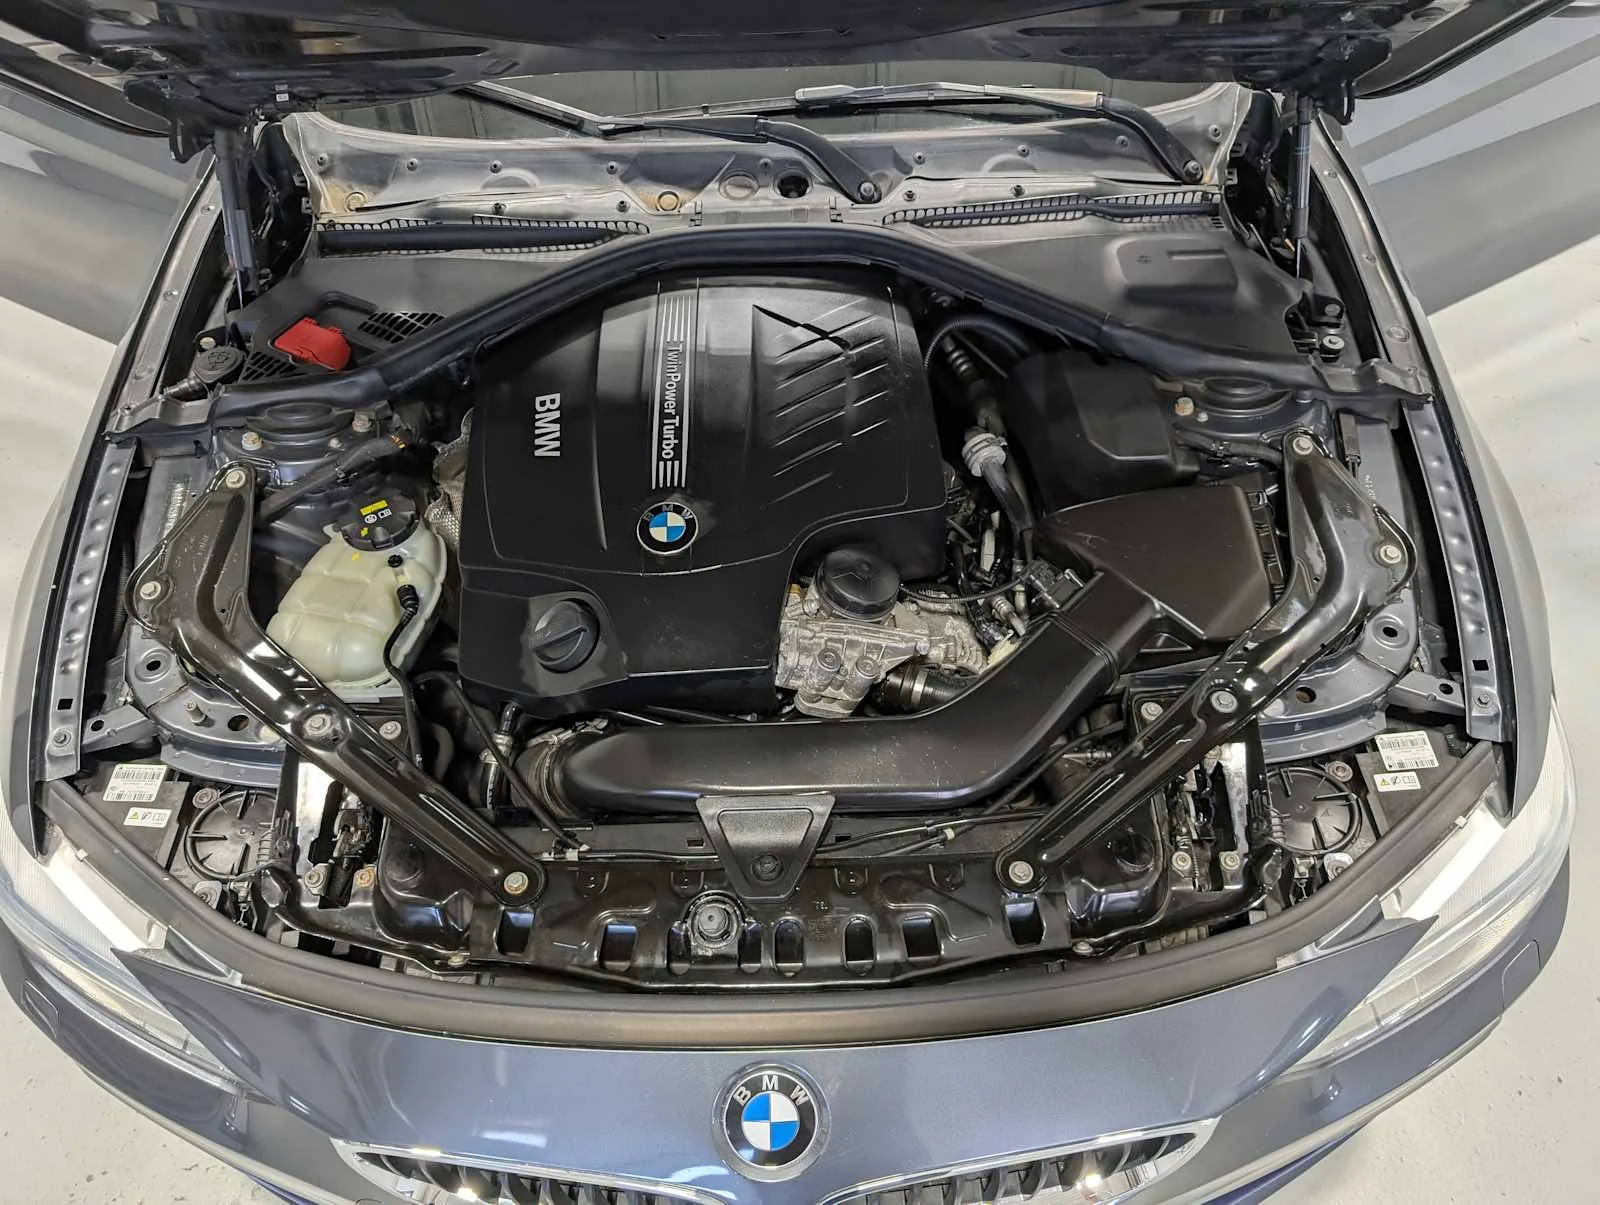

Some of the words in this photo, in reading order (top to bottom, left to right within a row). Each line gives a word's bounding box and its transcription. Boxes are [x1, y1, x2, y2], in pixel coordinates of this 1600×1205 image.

[664, 343, 682, 415] TwinPower
[534, 393, 561, 457] BMW
[661, 416, 680, 459] Turbo
[643, 504, 693, 521] BMW
[733, 1074, 810, 1107] BMW
